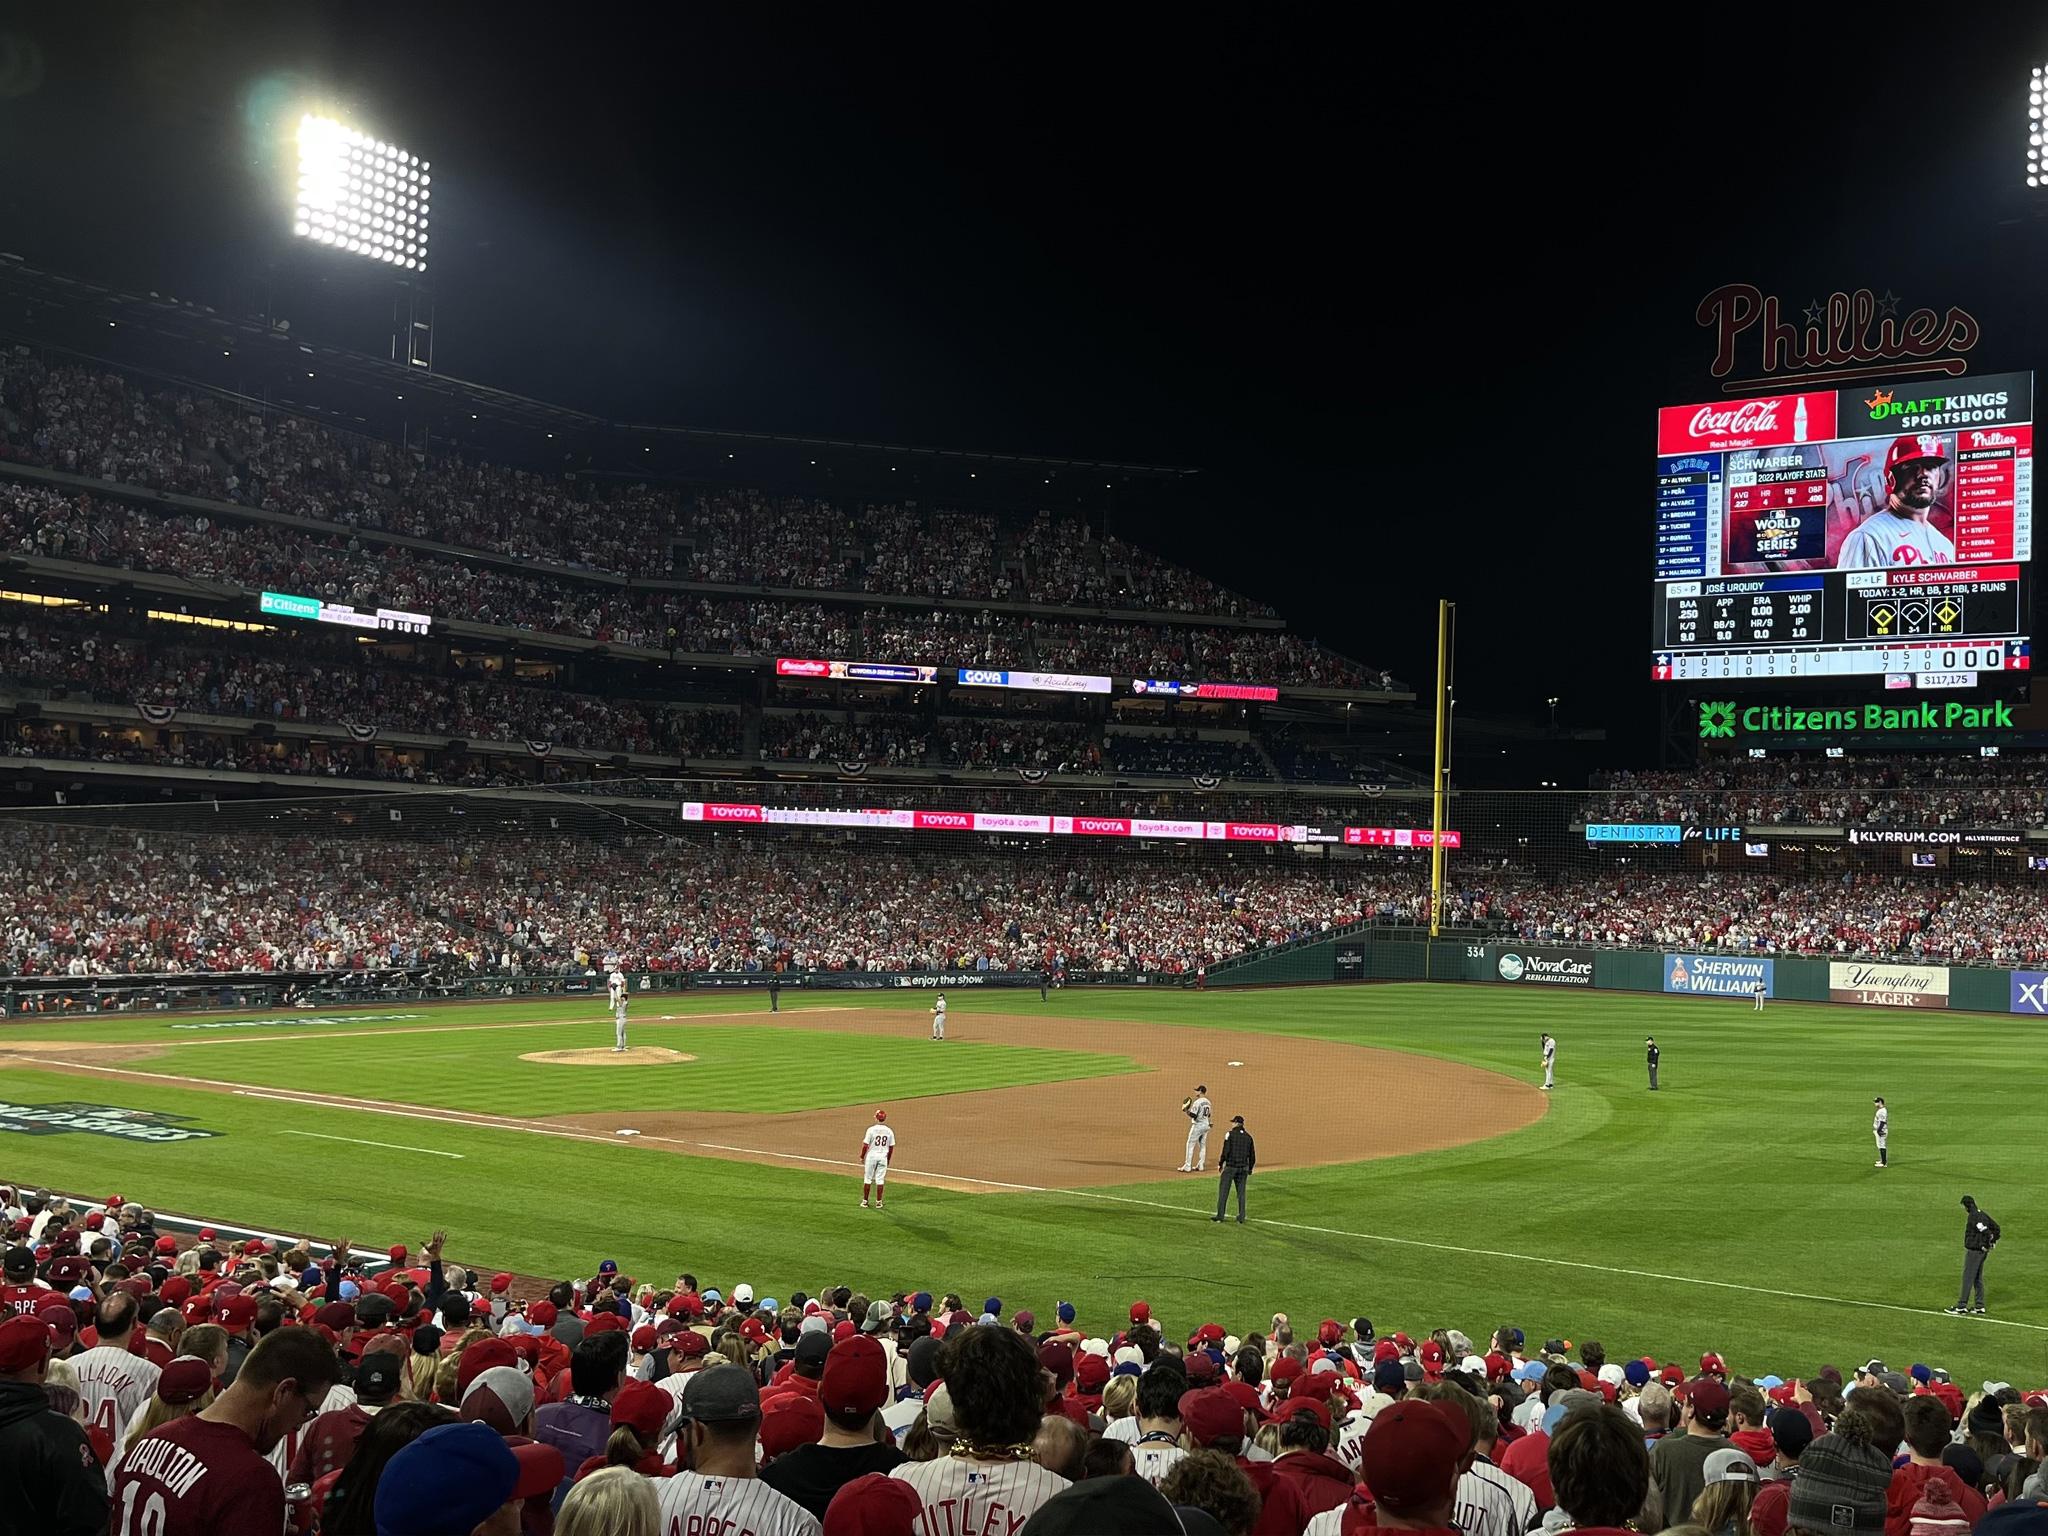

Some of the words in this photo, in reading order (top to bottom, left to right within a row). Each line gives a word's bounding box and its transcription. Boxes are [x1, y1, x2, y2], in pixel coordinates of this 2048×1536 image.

[1696, 284, 1979, 377] Phillies
[1869, 391, 2009, 420] DRAFTKINGS
[1689, 400, 1783, 437] Coca-Cola
[1902, 408, 2007, 428] SPORTSBOOK
[1710, 440, 1728, 448] Real
[1729, 438, 1754, 447] Magic
[1971, 431, 2017, 447] Phillies
[1972, 450, 2011, 459] SCHWARBER
[1671, 458, 1710, 473] ASTROS
[1729, 455, 1803, 471] SCHWARBER
[1732, 476, 1742, 484] 12
[1744, 475, 1753, 483] LF
[1758, 473, 1774, 482] 2022
[1776, 471, 1804, 481] PLAYOFF
[1805, 469, 1826, 478] STATS
[1734, 491, 1749, 499] AVG
[1808, 486, 1823, 494] OBP
[1971, 500, 2014, 508] CASTELLANOS
[1754, 517, 1801, 530] WORLD
[1971, 526, 1990, 534] STOTT
[1757, 538, 1798, 552] SERIES
[1851, 577, 1861, 585] 12
[1871, 576, 1882, 584] LF
[1893, 574, 1916, 583] KYLE
[1918, 570, 1978, 582] SCHWARBER
[1670, 584, 1683, 594] 65
[1690, 585, 1696, 593] P
[1705, 582, 1724, 595] JOSÉ
[1727, 582, 1764, 592] URQUIDY
[1858, 588, 1890, 598] TODAY:
[1892, 588, 1908, 597] 1-2,
[1910, 587, 1924, 596] HR,
[1927, 586, 1942, 596] BB,
[1944, 585, 1950, 594] 2
[1952, 584, 1970, 594] RBI,
[1972, 584, 1978, 592] 2
[1980, 582, 2006, 592] RUNS
[273, 600, 316, 614] Citizens
[1680, 600, 1698, 608] BAA
[1717, 598, 1734, 606] APP
[1754, 596, 1771, 605] ERA
[1788, 594, 1812, 604] WHIP
[1678, 610, 1698, 620] .250
[1721, 608, 1728, 617] 1
[1752, 606, 1772, 616] 0.00
[1790, 604, 1811, 614] 2.00
[1680, 622, 1696, 630] K/9
[1714, 620, 1736, 629] BB/9
[1750, 618, 1774, 628] HR/9
[1796, 617, 1804, 626] IP
[1940, 624, 1952, 632] HR
[1680, 633, 1696, 642] 9.0
[1716, 631, 1732, 640] 9.0
[1754, 629, 1770, 639] 0.0
[1792, 628, 1808, 638] 1.0
[1680, 658, 1686, 667] 0
[1702, 658, 1708, 666] 0
[1724, 657, 1730, 666] 0
[1746, 656, 1752, 665] 0
[1768, 656, 1774, 664] 0
[1791, 654, 1797, 664] 0
[1814, 654, 1820, 662] 0
[1882, 651, 1889, 660] 0
[1904, 650, 1910, 660] 5
[1924, 650, 1931, 660] 0
[2013, 646, 2020, 656] 4
[1944, 652, 1956, 668] 0
[1965, 651, 1978, 668] 0
[1986, 650, 2000, 667] 0
[1680, 669, 1686, 677] 2
[1702, 668, 1708, 677] 2
[1724, 668, 1730, 676] 0
[1746, 667, 1752, 676] 0
[1768, 666, 1774, 675] 3
[1791, 666, 1797, 674] 0
[1882, 662, 1888, 671] 7
[1904, 662, 1909, 671] 7
[1924, 661, 1931, 670] 0
[2013, 658, 2020, 668] 4
[965, 671, 1002, 683] GOYA
[1043, 675, 1089, 690] Academy
[1924, 675, 1968, 685] $117,175
[1742, 706, 1856, 732] Citizens
[1864, 702, 1938, 730] Bank
[1945, 700, 2014, 728] Park
[711, 807, 758, 818] TOYOTA
[921, 814, 968, 826] TOYOTA
[982, 816, 1040, 829] toyota.com
[1080, 820, 1124, 832] TOYOTA
[1138, 823, 1194, 834] toyota.com
[1232, 826, 1276, 836] TOYOTA
[1588, 826, 1678, 839] DENTISTRY
[1683, 826, 1703, 841] for
[1706, 828, 1741, 841] LIFE
[1860, 832, 1961, 844] KLYRRUM.COM
[1418, 834, 1458, 844] TOOTA
[1467, 946, 1484, 958] 334
[1524, 956, 1592, 976] NovaCare
[1691, 958, 1764, 978] SHERWIN
[912, 976, 939, 988] enjoy
[940, 975, 956, 984] the
[958, 975, 984, 984] show.
[1525, 973, 1590, 984] REHABILITATION
[1690, 974, 1766, 996] WILLIAM
[1843, 965, 1933, 992] Yuengling
[1862, 992, 1916, 1006] LAGER
[2018, 976, 2048, 1012] xf
[874, 1135, 888, 1147] 38
[60, 1266, 70, 1274] P
[186, 1303, 195, 1314] P
[221, 1308, 230, 1321] P
[77, 1363, 134, 1393] LLADAY
[123, 1437, 208, 1500] DAULTON
[119, 1480, 167, 1536] 10
